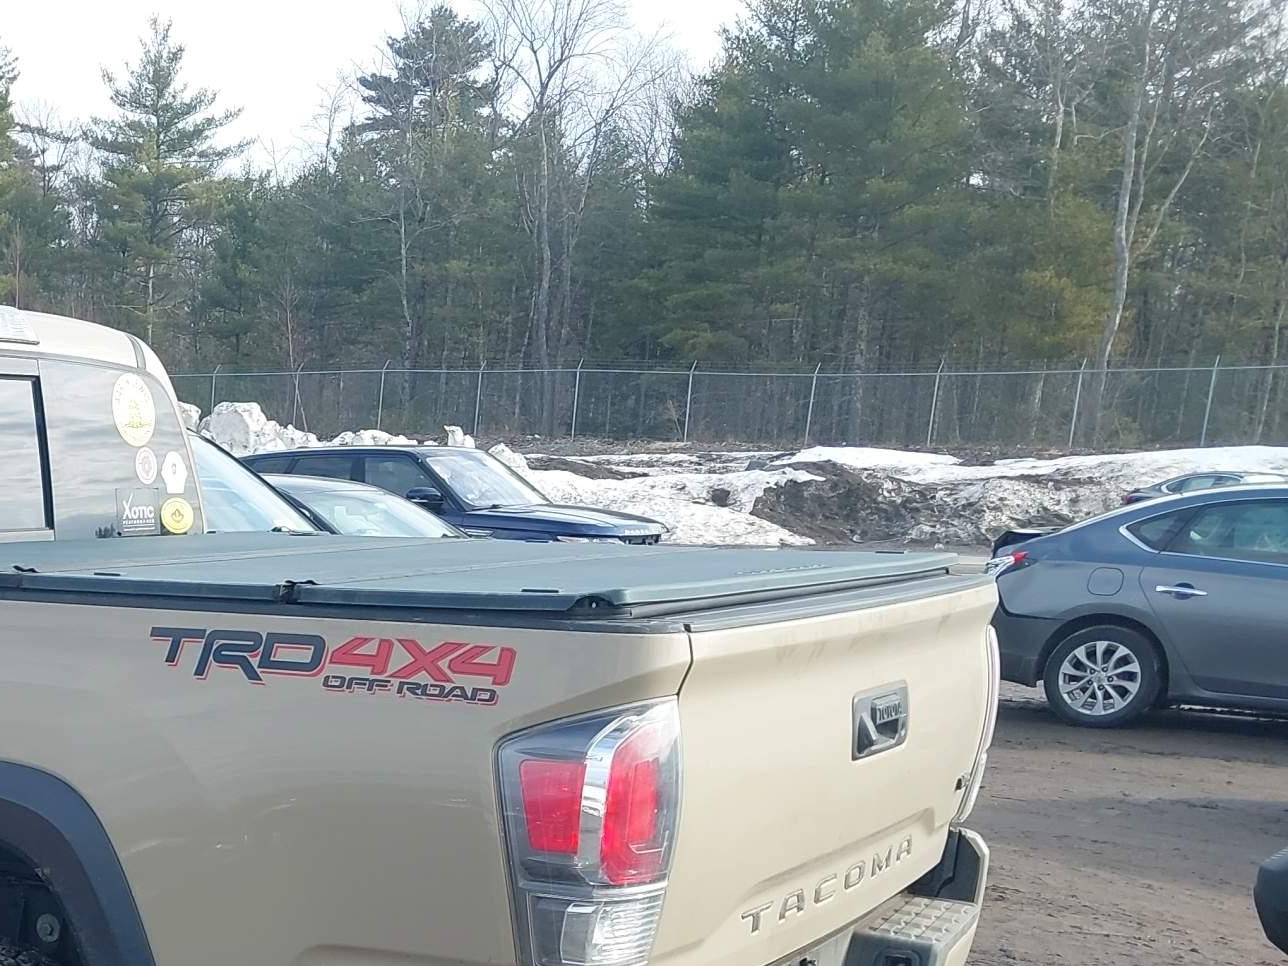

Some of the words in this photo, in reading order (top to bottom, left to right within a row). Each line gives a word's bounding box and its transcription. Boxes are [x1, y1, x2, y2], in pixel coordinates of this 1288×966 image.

[150, 627, 329, 685] TRD
[323, 674, 392, 693] OFF
[396, 681, 498, 705] ROAD
[741, 835, 912, 934] TACOMA
